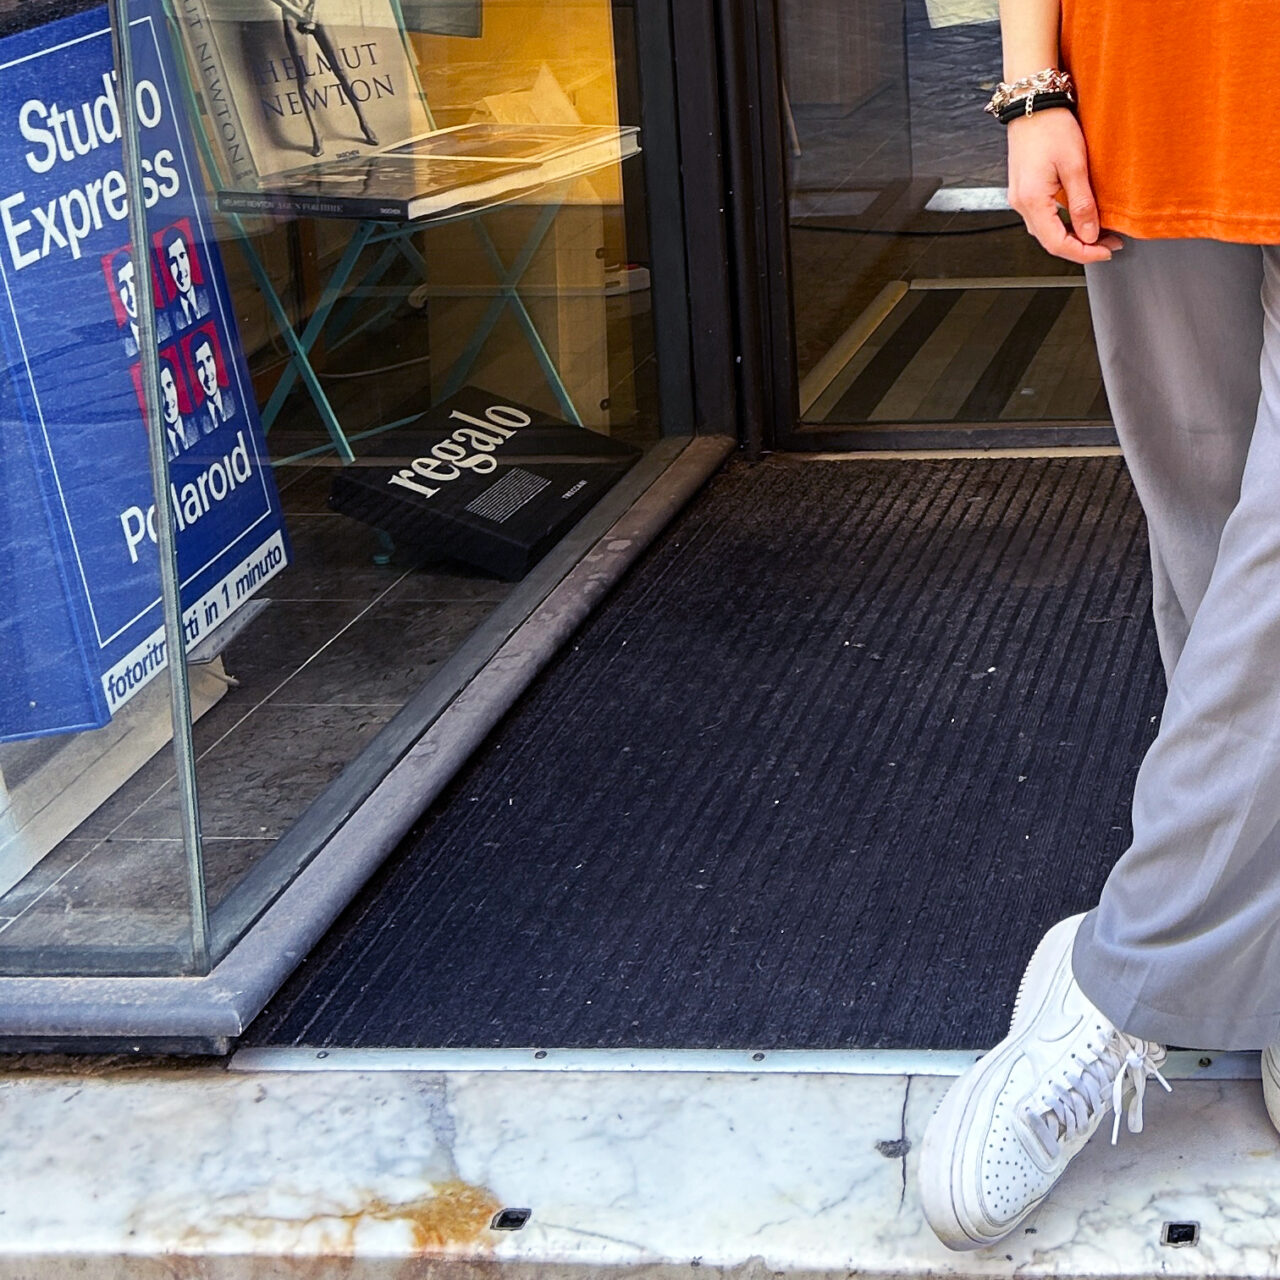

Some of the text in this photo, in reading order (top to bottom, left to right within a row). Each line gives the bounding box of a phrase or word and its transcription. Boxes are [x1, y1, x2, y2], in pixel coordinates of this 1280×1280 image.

[196, 41, 245, 166] NEWTON
[257, 42, 378, 87] HELMUT
[260, 74, 395, 120] NEWTON
[19, 70, 162, 174] Studo
[0, 149, 180, 271] Express
[387, 405, 532, 499] regalo
[204, 600, 219, 628] in
[221, 583, 232, 611] 1
[236, 544, 283, 600] minuto
